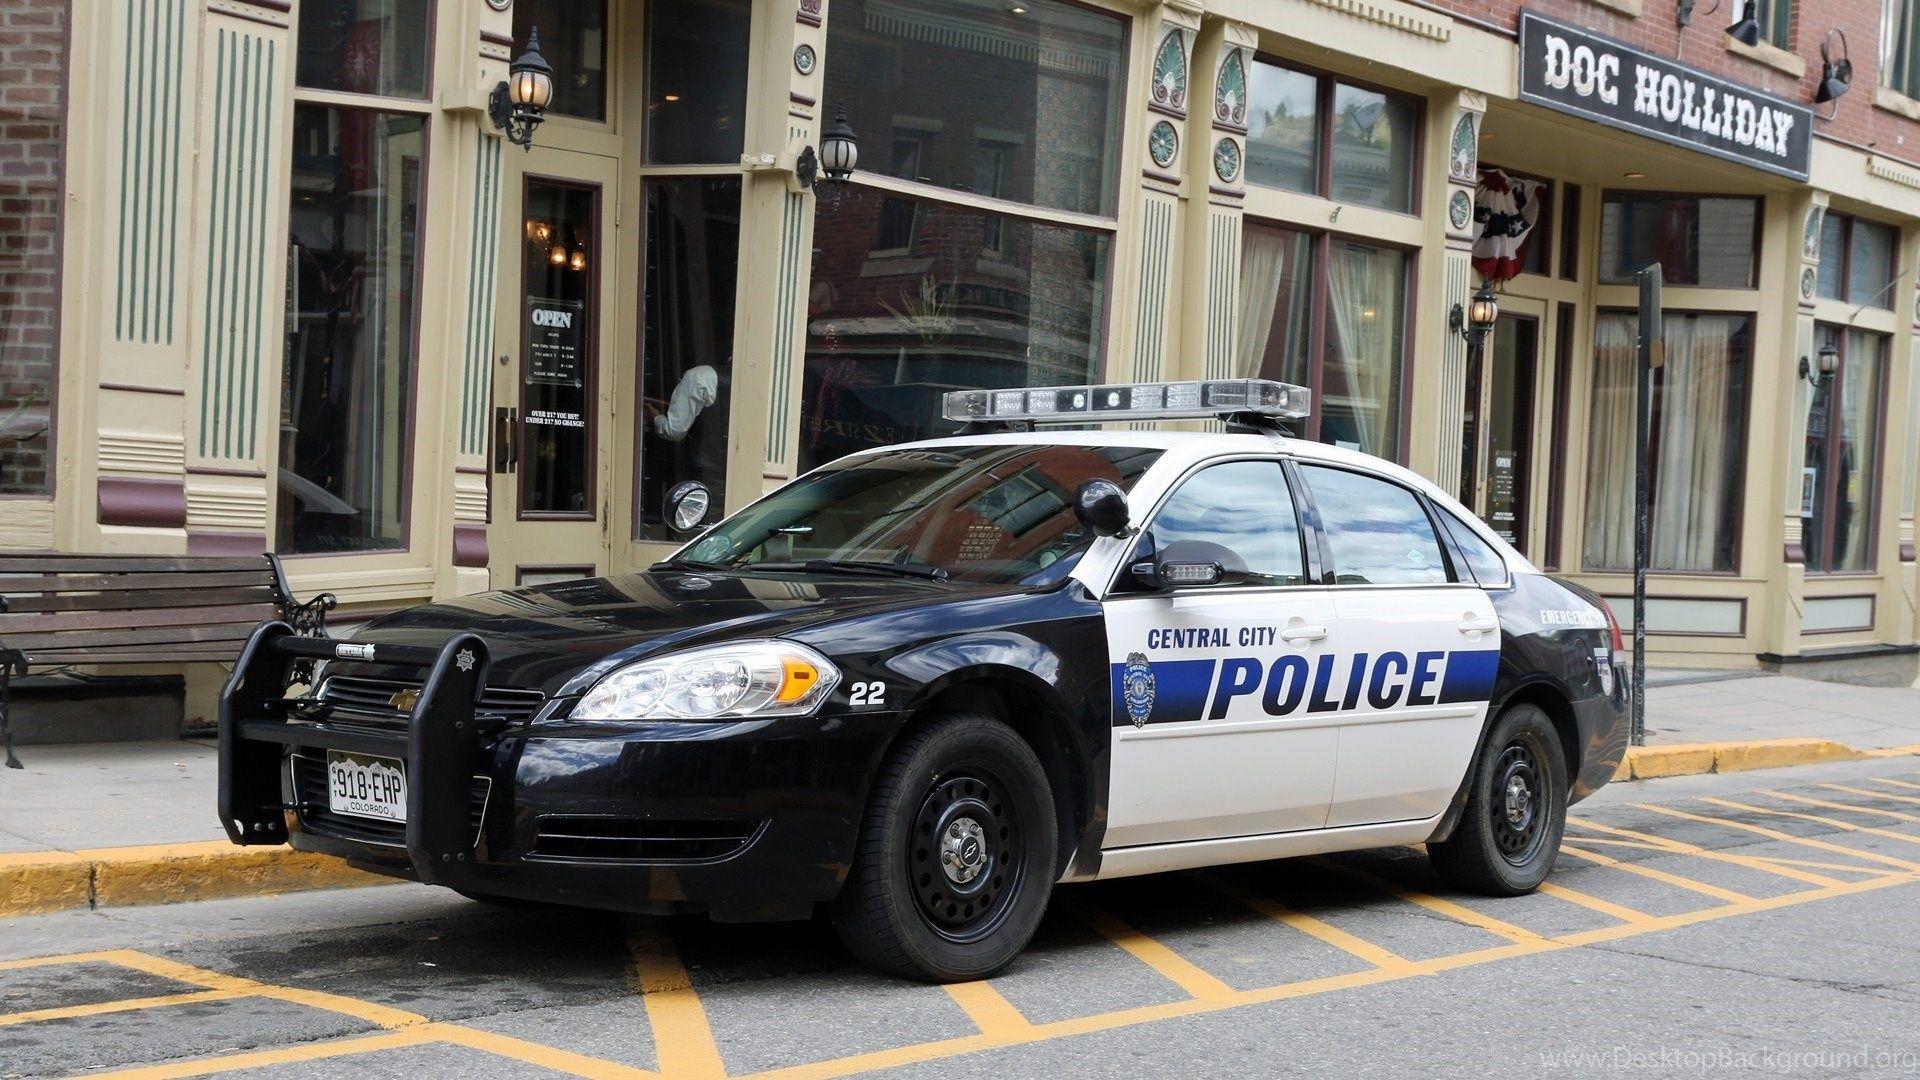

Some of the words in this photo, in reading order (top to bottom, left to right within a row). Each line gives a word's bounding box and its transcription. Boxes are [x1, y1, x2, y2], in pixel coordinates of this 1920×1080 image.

[1545, 34, 1620, 105] DOC
[1634, 64, 1793, 157] HOLLIDAY
[532, 308, 572, 328] OPEN
[1496, 457, 1511, 468] OPEN
[1147, 627, 1231, 650] CENTRAL
[1238, 626, 1277, 647] CITY
[849, 681, 886, 706] 22
[1207, 650, 1446, 720] POLICE
[350, 801, 389, 815] COLORADO
